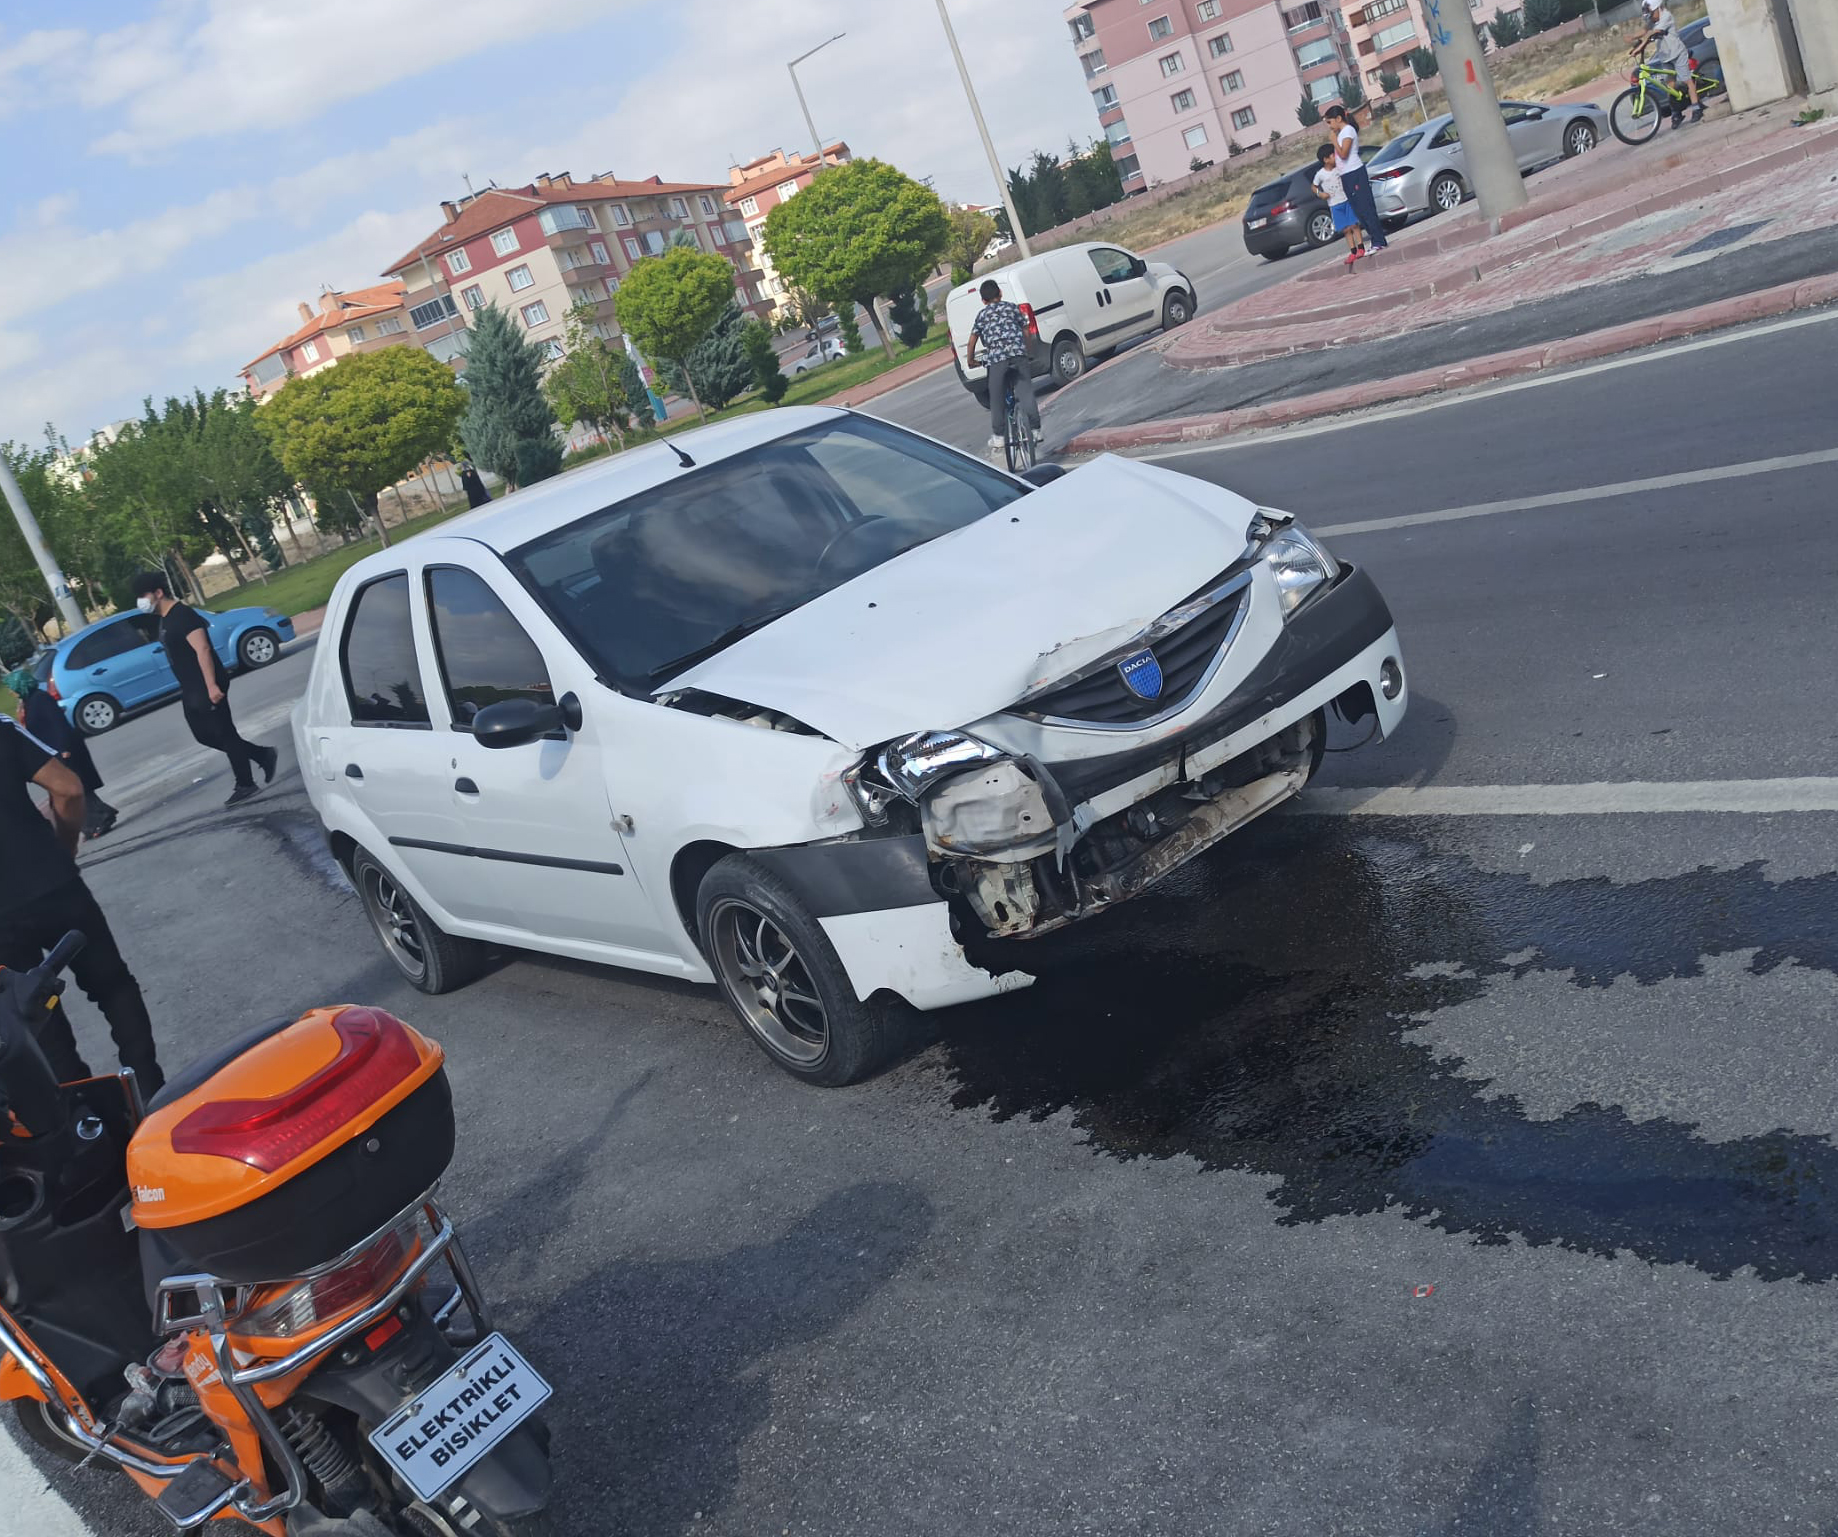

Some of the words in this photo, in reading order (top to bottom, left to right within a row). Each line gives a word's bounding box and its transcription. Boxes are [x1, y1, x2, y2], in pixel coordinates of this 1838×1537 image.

[1124, 656, 1153, 673] DACIA
[395, 1353, 516, 1462] ELEKTRİKLİ
[429, 1382, 521, 1468] BİSİKLET
